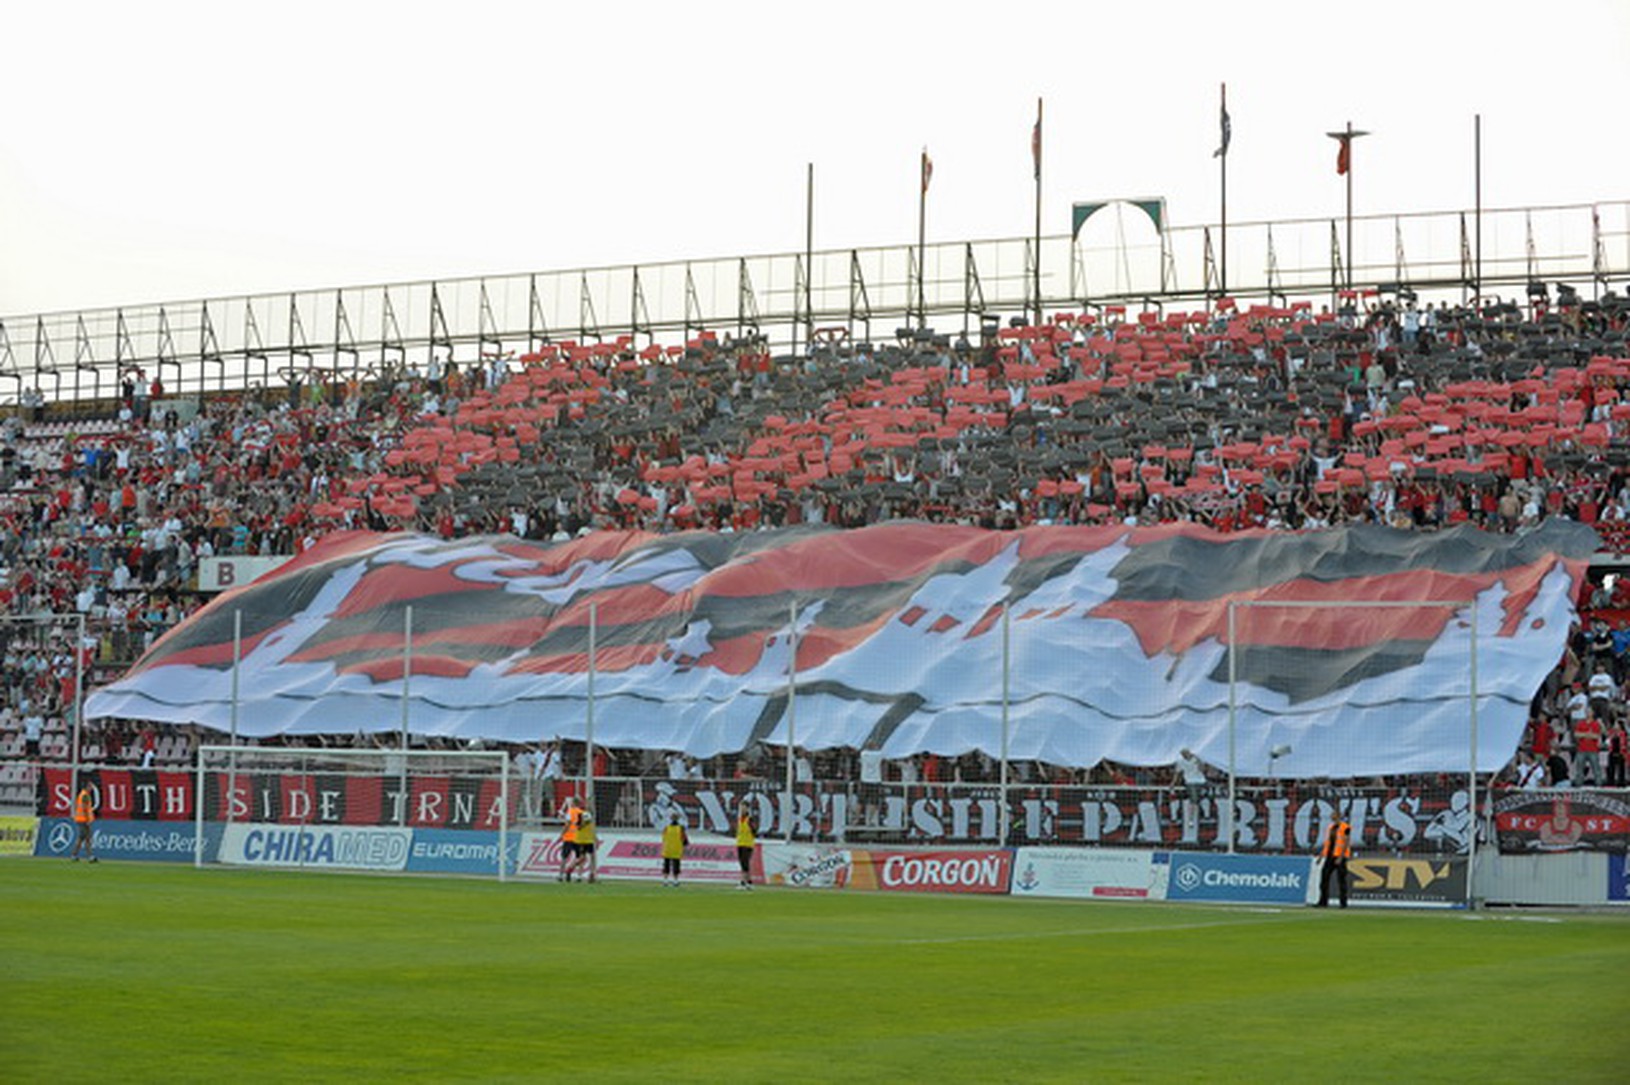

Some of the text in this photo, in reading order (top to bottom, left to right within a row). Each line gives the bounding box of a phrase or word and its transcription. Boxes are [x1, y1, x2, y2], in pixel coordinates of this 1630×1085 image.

[218, 562, 234, 586] B
[226, 789, 341, 821] SIDE
[1081, 796, 1418, 848] PATRIOTS
[1511, 817, 1613, 832] FC ST
[244, 830, 407, 866] CHIRAMED
[1203, 869, 1301, 889] Chemolak
[1347, 858, 1449, 889] STV
